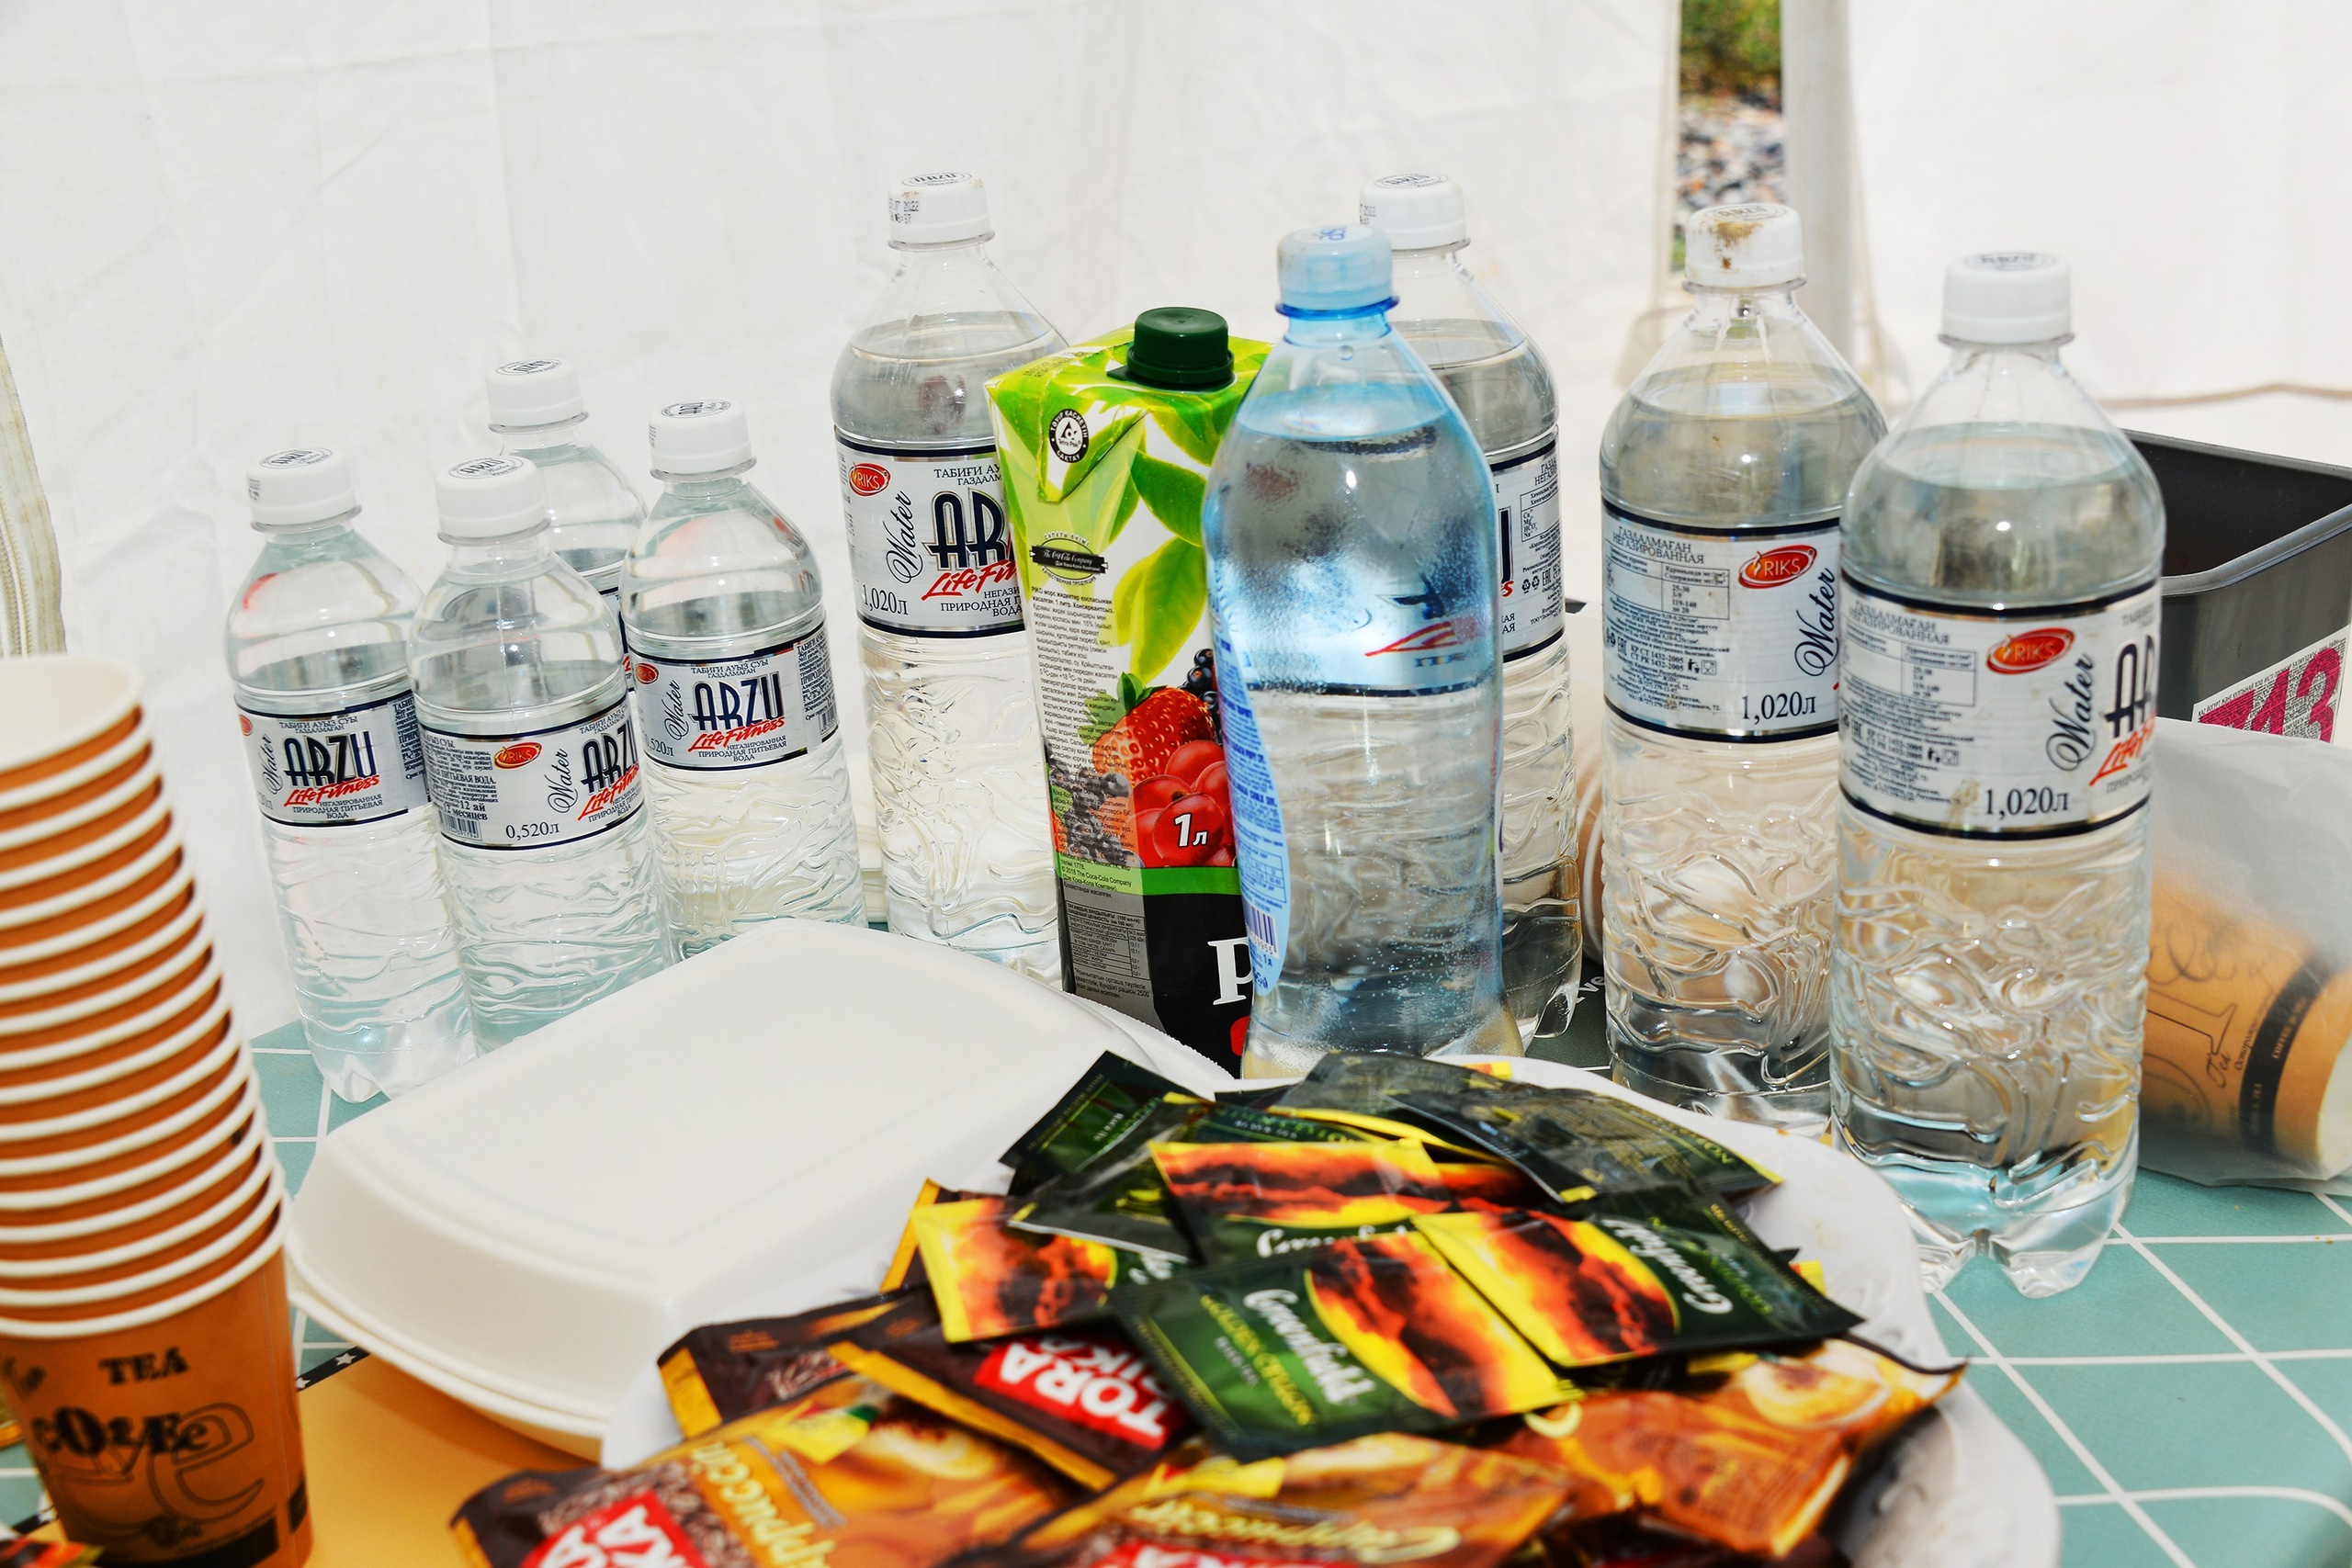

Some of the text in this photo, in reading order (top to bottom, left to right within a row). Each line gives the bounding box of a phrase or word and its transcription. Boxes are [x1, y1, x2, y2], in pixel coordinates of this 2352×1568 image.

[857, 474, 880, 490] RIKS
[957, 474, 1002, 486] ГАЗДАЛМ
[986, 464, 1001, 475] АУ
[883, 490, 923, 584] Water
[922, 487, 1015, 570] AR
[1613, 533, 1704, 564] НЕГАЗИРОВАННАЯ
[1764, 558, 1802, 577] RIKS
[863, 584, 909, 615] 1,020л
[941, 599, 1011, 613] ПРИРОДНАЯ
[1794, 567, 1838, 677] Water
[2013, 642, 2056, 662] RIKS
[726, 663, 749, 673] АУЫЗ
[752, 660, 768, 668] СУЫ
[662, 680, 689, 740] Water
[687, 671, 784, 731] ARZU
[1741, 691, 1816, 725] 1,020л
[2046, 653, 2097, 772] Water
[338, 716, 357, 726] СУЫ
[698, 741, 787, 758] ПРИРОДНАЯ ПИТЬЕВАЯ
[727, 736, 786, 750] НЕГАЗИРОВАННАЯ
[263, 734, 283, 795] Water
[283, 730, 378, 787] ARZU
[544, 749, 579, 814] Water
[293, 799, 383, 814] ПРИРОДНАЯ ПИТЬЕВАЯ
[327, 810, 349, 819] ВОДА
[452, 808, 488, 820] месяцев
[460, 801, 486, 811] 12 ай
[1984, 786, 2069, 820] 1,020л
[505, 822, 560, 840] 0,520л
[97, 1346, 190, 1385] TEA
[1000, 1341, 1169, 1438] TORA
